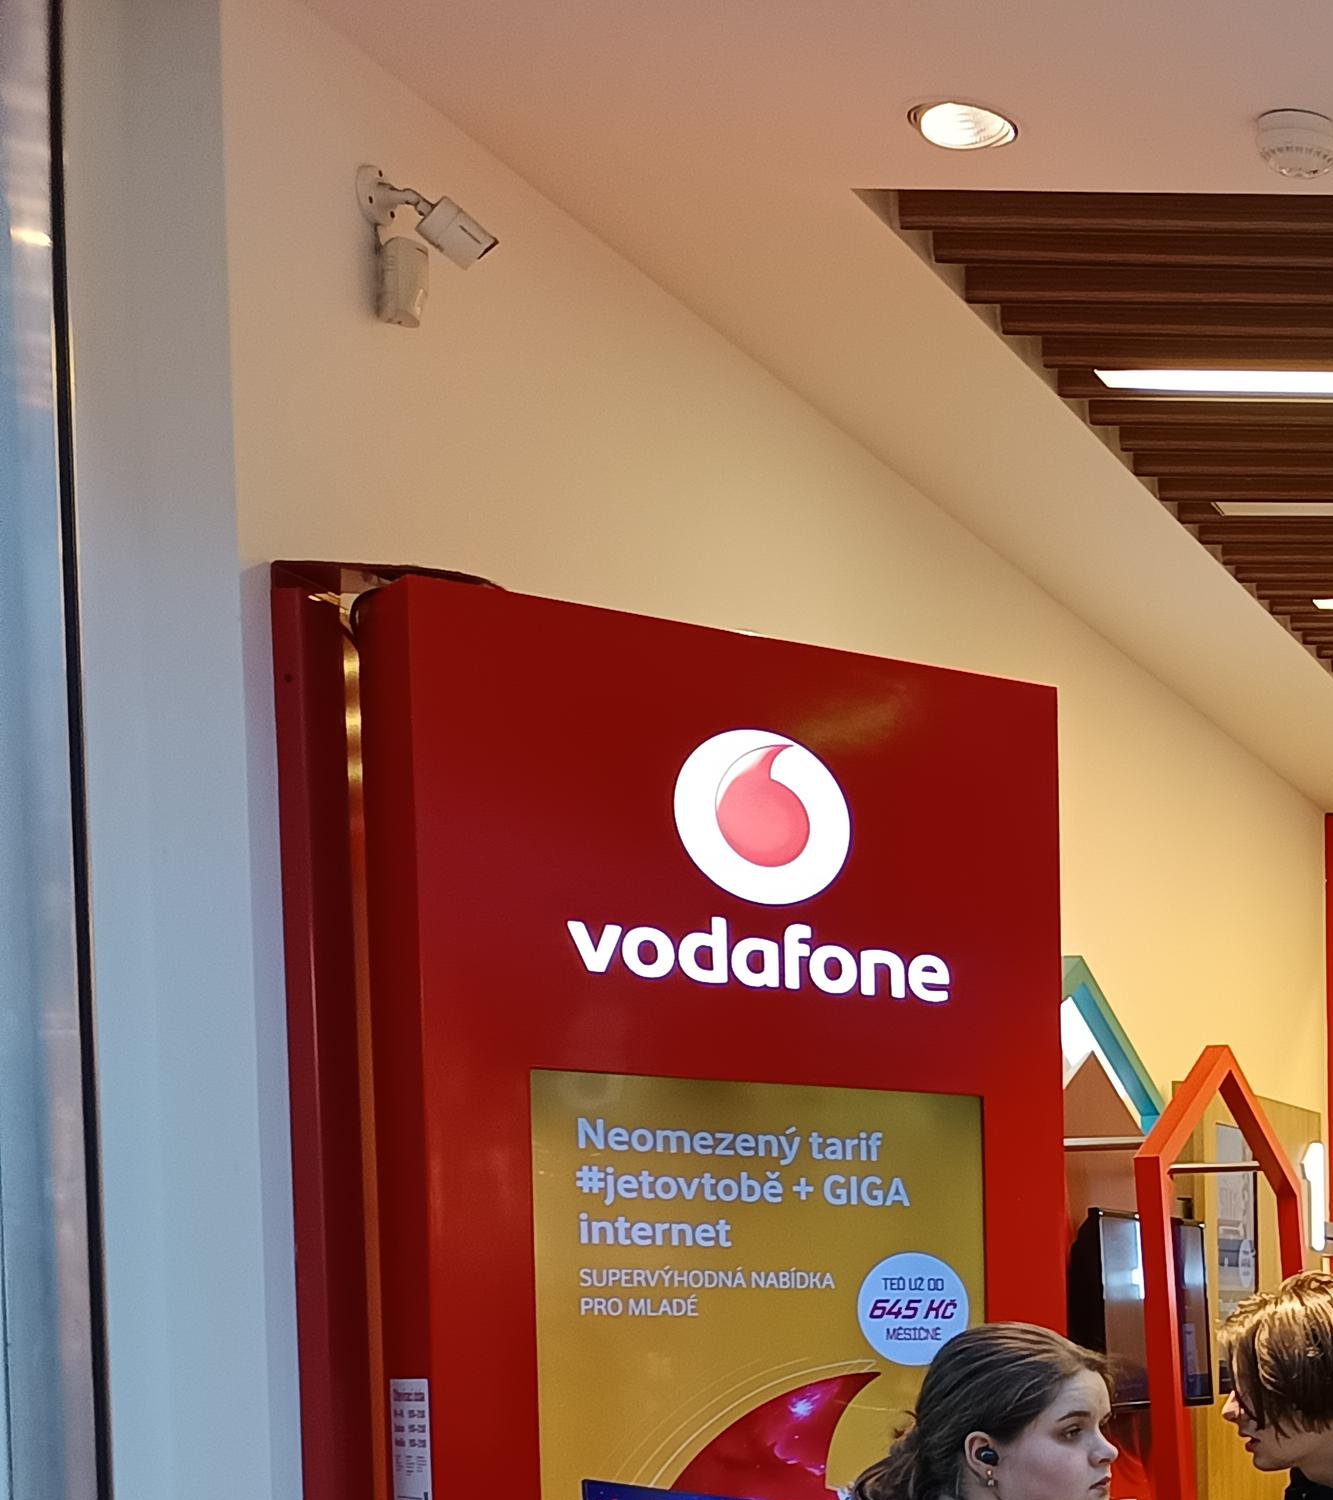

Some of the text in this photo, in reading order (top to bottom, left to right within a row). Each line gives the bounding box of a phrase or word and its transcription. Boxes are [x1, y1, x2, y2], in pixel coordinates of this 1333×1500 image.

[566, 916, 950, 1002] vodafone
[576, 1117, 883, 1165] Neomezený tarif
[576, 1166, 910, 1207] #jetovtobě + GIGA
[1300, 1142, 1325, 1251] 1
[579, 1212, 733, 1248] internet
[579, 1266, 836, 1289] SUPERVÝHODNÁ NABÍDKA
[881, 1276, 944, 1291] TEĎ UŽ OD
[580, 1294, 699, 1317] PRO MLADÉ
[869, 1299, 922, 1319] 645
